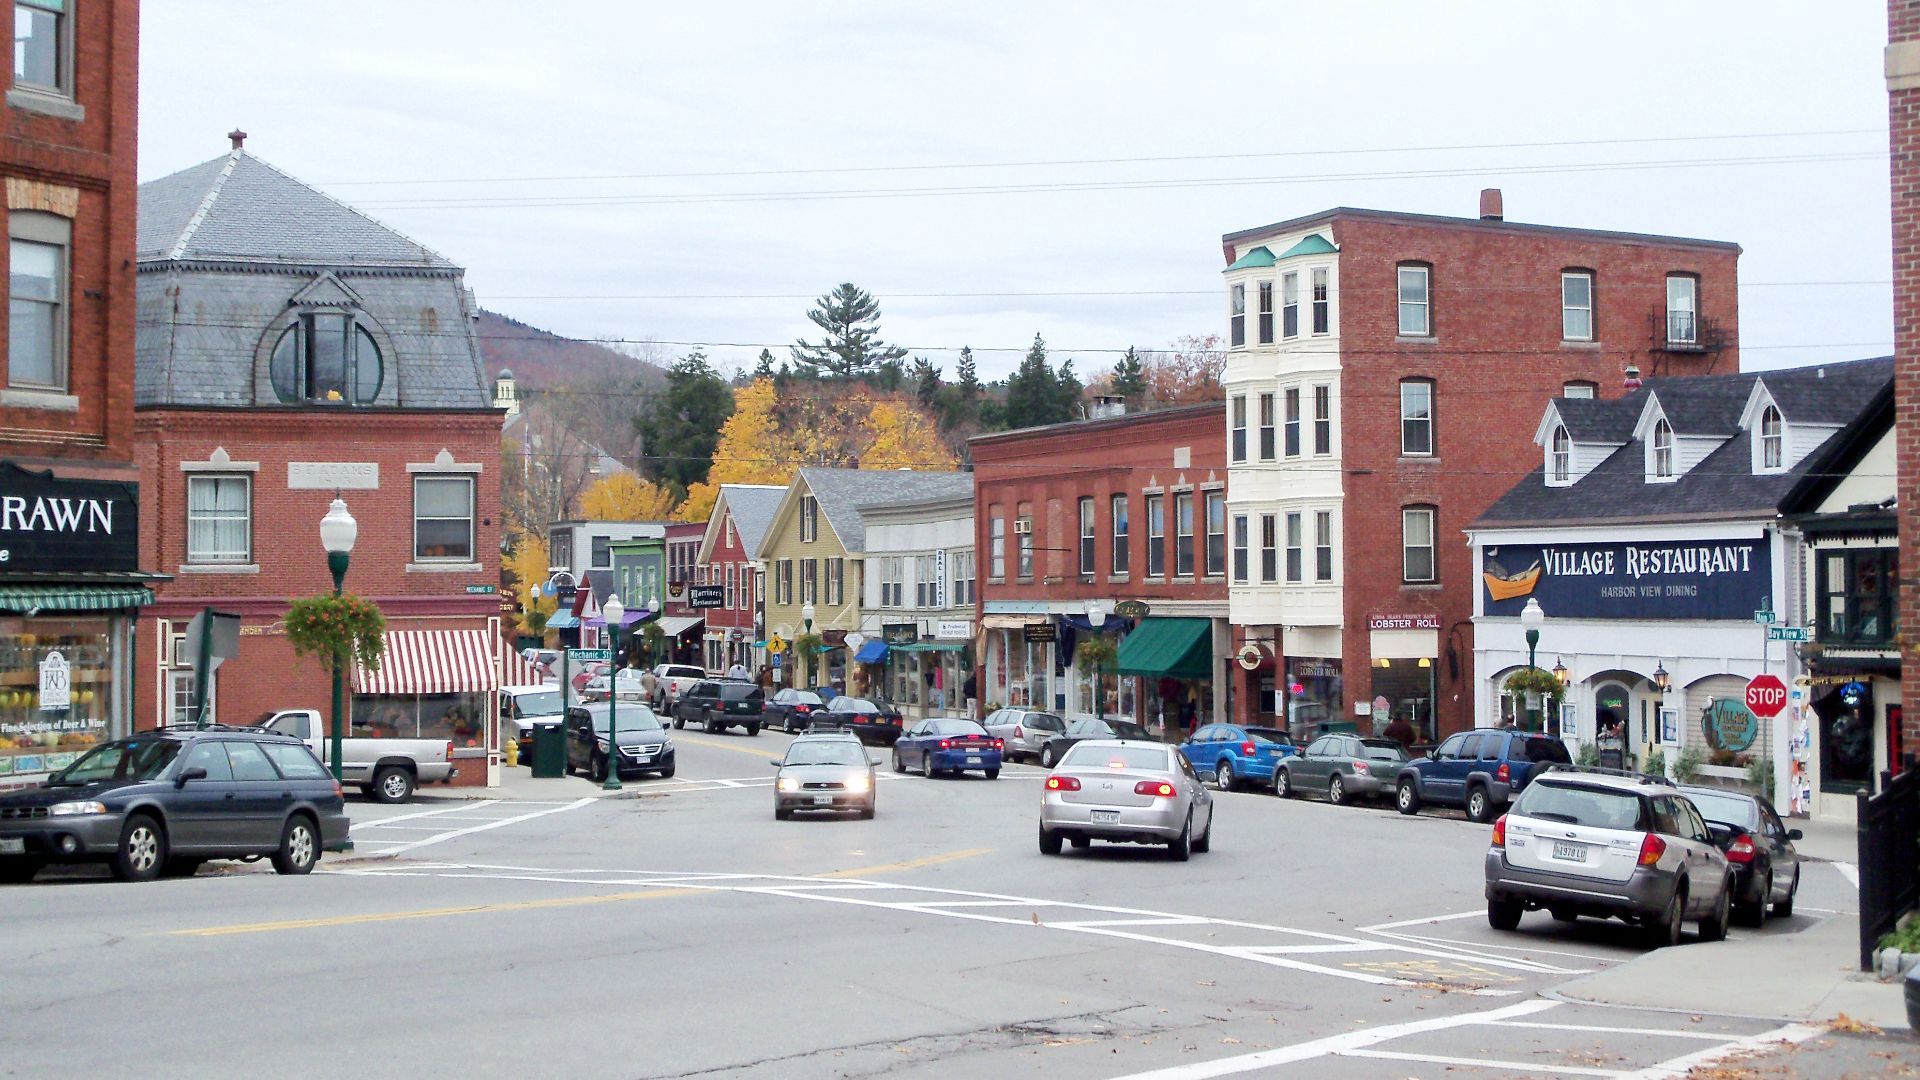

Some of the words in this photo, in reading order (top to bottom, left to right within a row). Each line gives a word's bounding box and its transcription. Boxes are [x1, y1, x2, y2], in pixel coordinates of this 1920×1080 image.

[1542, 549, 1615, 577] VILLAGE
[1625, 546, 1753, 580] RESTAURANT
[1601, 586, 1636, 599] HARBOR
[1640, 585, 1662, 598] VIEW
[1665, 584, 1698, 597] DINING
[1370, 619, 1412, 629] LOBSTER
[1416, 619, 1440, 628] ROLL
[1768, 629, 1781, 639] Bay
[1781, 629, 1798, 639] View
[1799, 629, 1807, 640] St
[569, 650, 599, 659] Mechanic
[602, 650, 609, 659] St
[1300, 666, 1325, 677] LOBSTER
[1747, 687, 1785, 705] STOP
[53, 720, 62, 730] of
[88, 718, 106, 729] Wine
[1559, 846, 1576, 858] 1978
